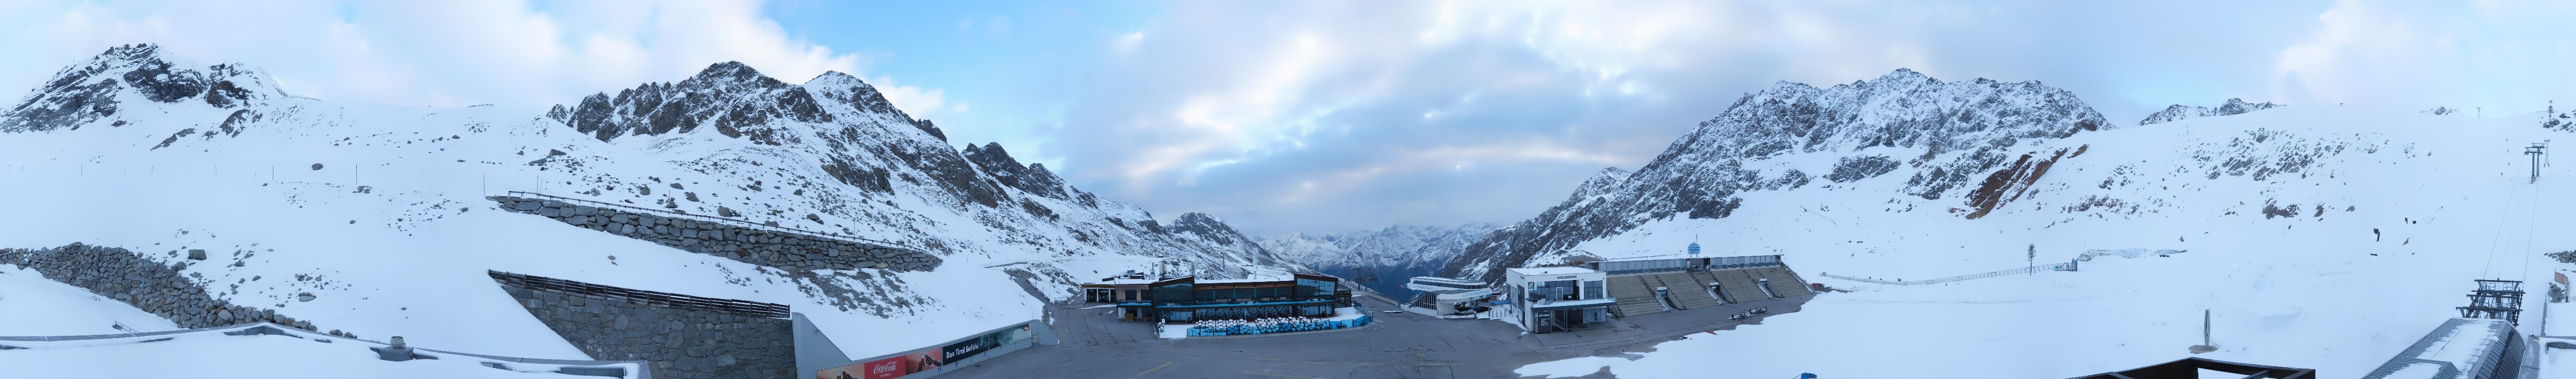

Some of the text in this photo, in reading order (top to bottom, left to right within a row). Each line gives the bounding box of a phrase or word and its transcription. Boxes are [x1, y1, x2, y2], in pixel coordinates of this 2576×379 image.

[955, 346, 965, 356] Tirol
[966, 342, 979, 352] Gefühl
[873, 361, 897, 374] Coca-Cola
